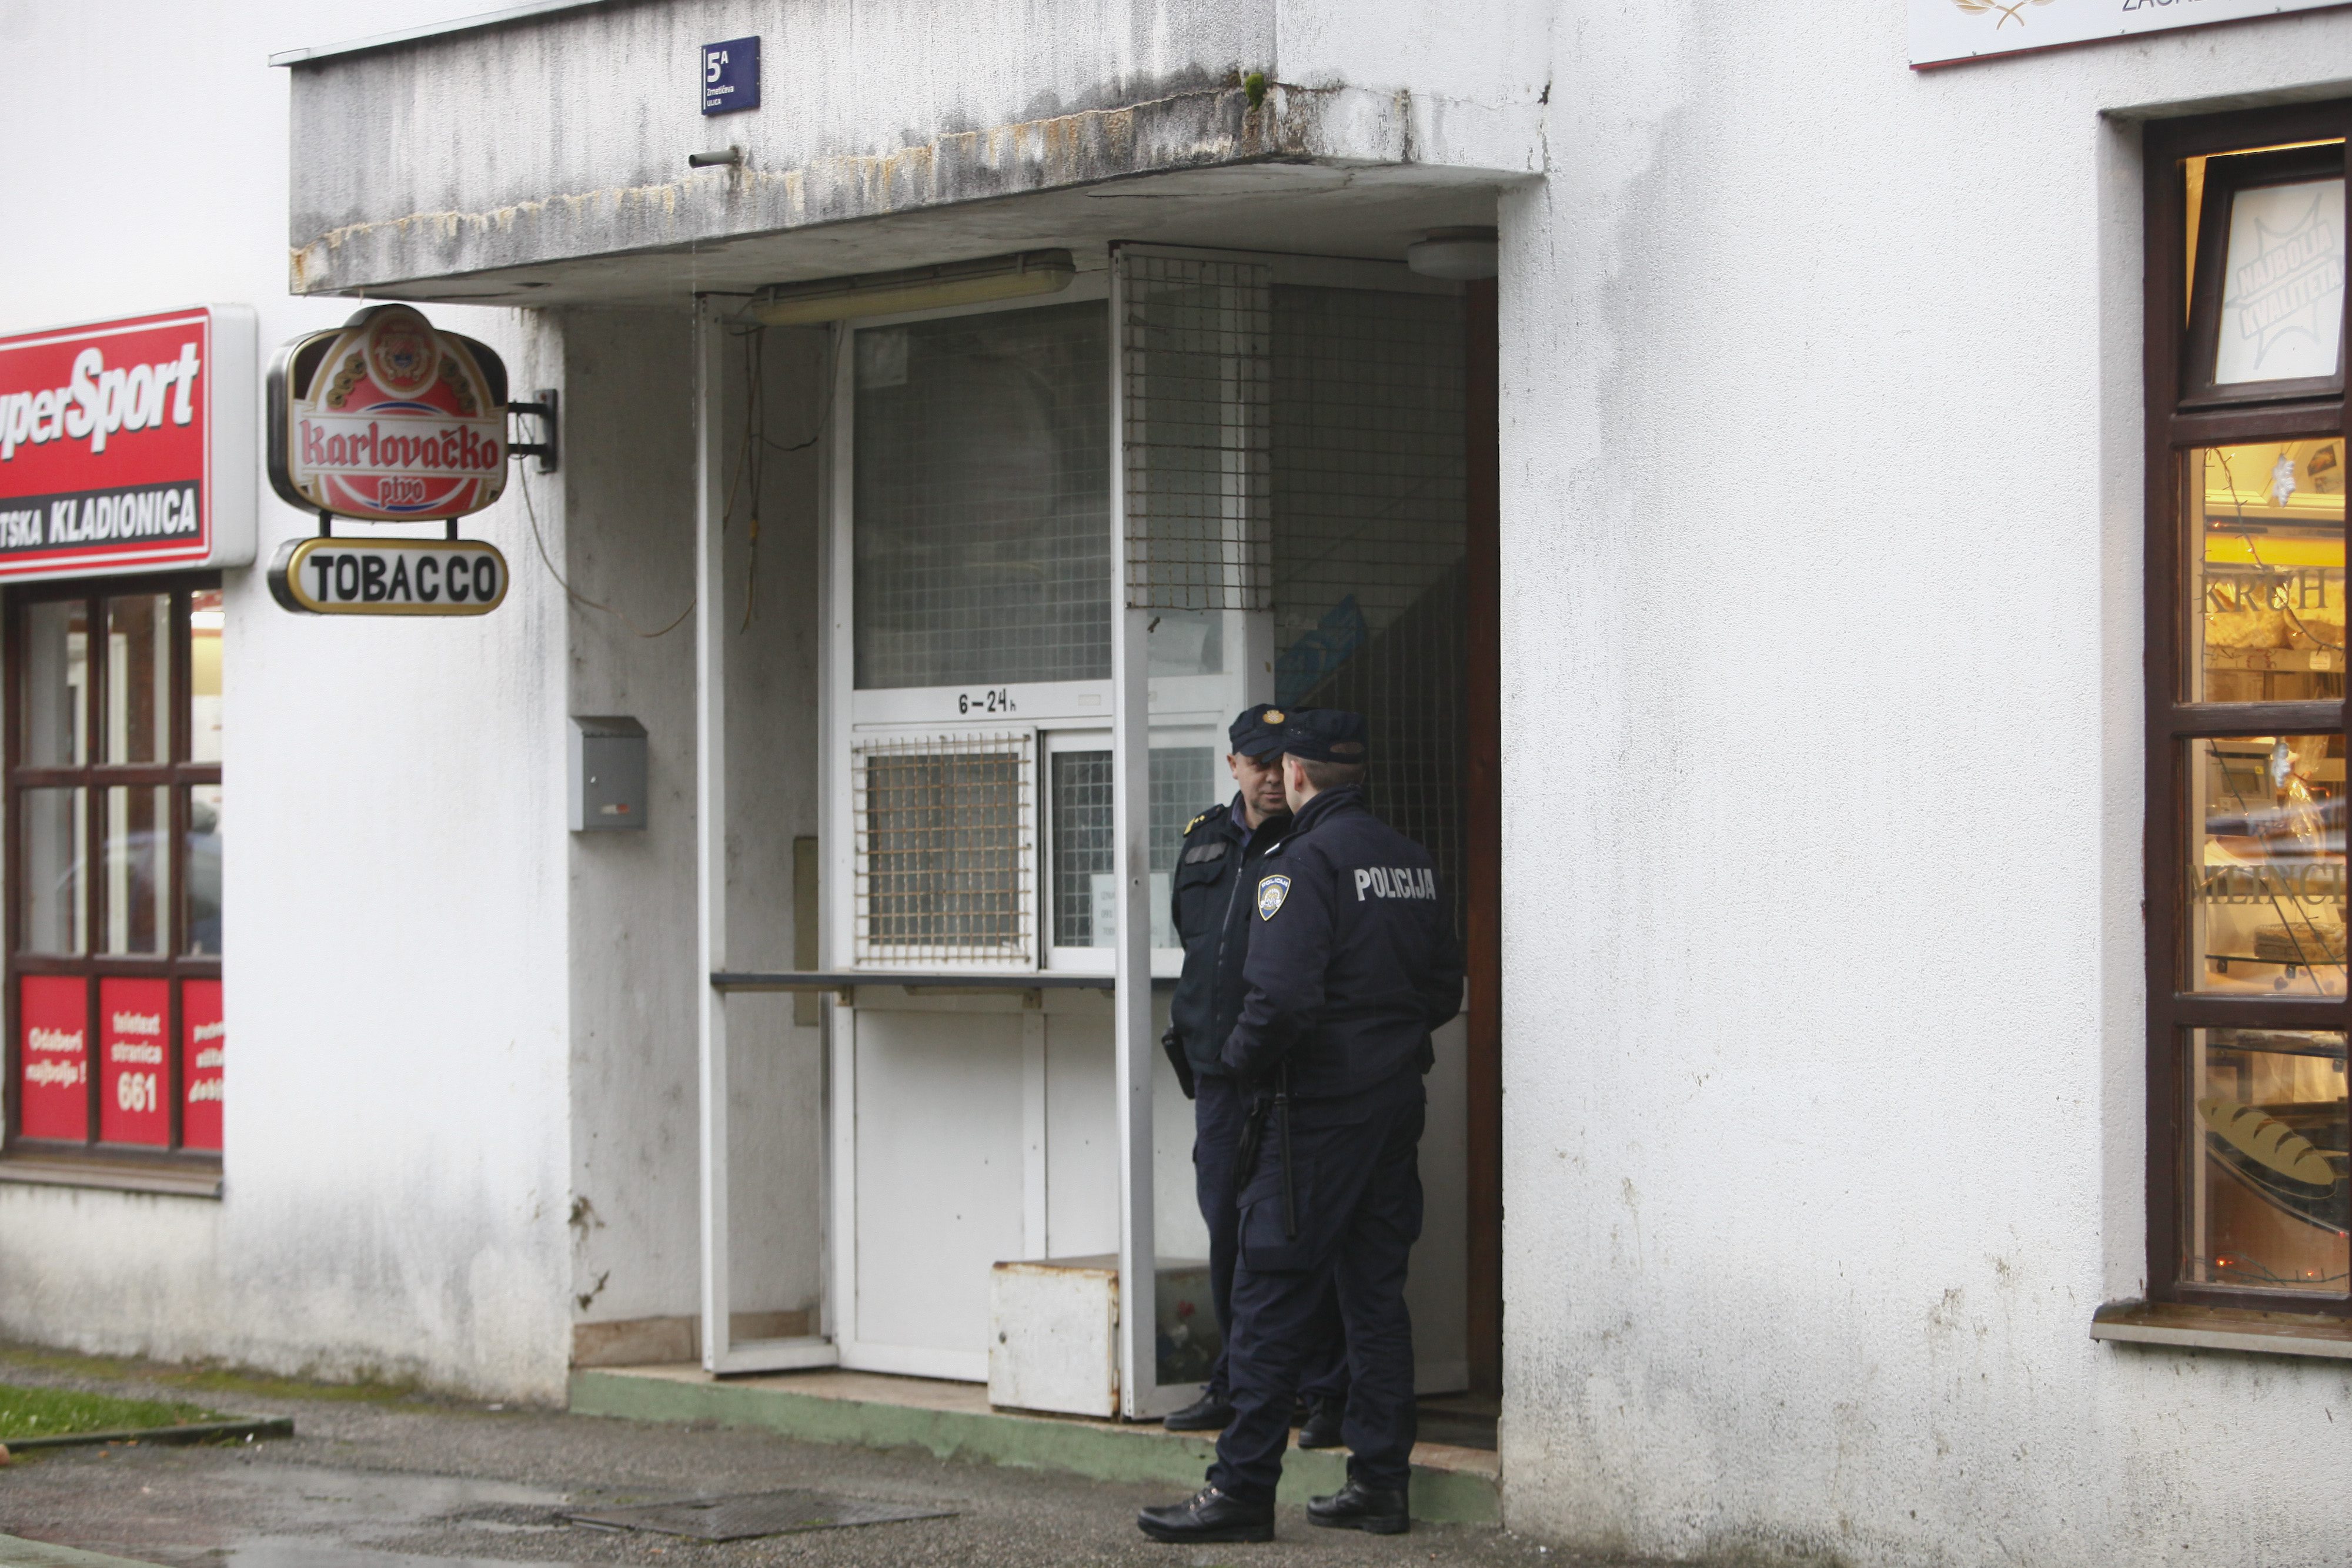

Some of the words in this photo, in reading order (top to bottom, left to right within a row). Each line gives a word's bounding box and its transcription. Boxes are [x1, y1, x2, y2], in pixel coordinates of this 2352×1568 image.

[707, 98, 722, 106] ULICA
[379, 477, 425, 509] pivo
[49, 489, 198, 544] KLADIONICA
[310, 554, 496, 603] TOBACCO
[2197, 569, 2328, 614] KRUH
[1261, 878, 1289, 888] POLICIJA
[1354, 867, 1436, 902] POLICIJA
[2186, 863, 2344, 905] MLINCI
[111, 1041, 162, 1065] stranica
[118, 1071, 156, 1113] 661
